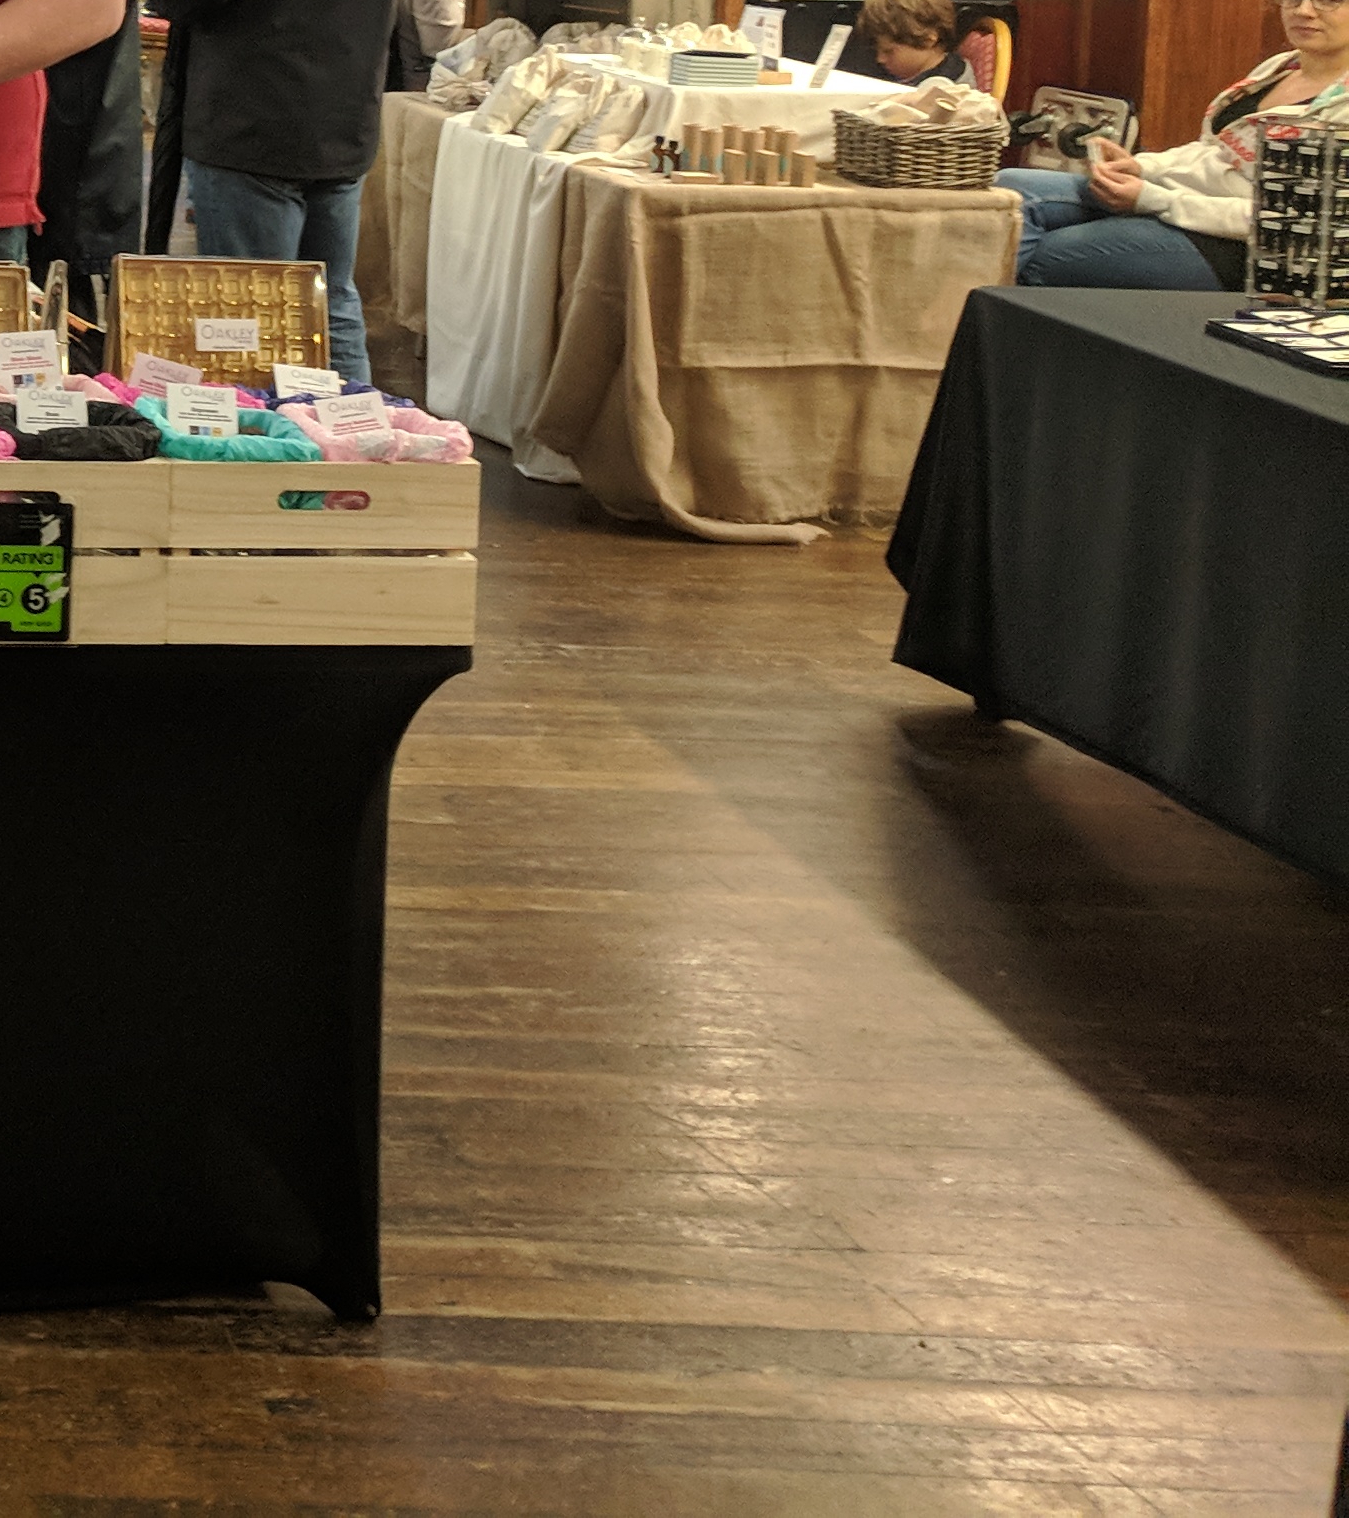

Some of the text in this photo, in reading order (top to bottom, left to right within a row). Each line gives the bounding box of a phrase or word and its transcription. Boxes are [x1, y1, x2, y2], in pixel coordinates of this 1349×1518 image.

[201, 324, 254, 340] OAKLEY
[3, 553, 54, 565] RATING
[27, 587, 45, 611] 5
